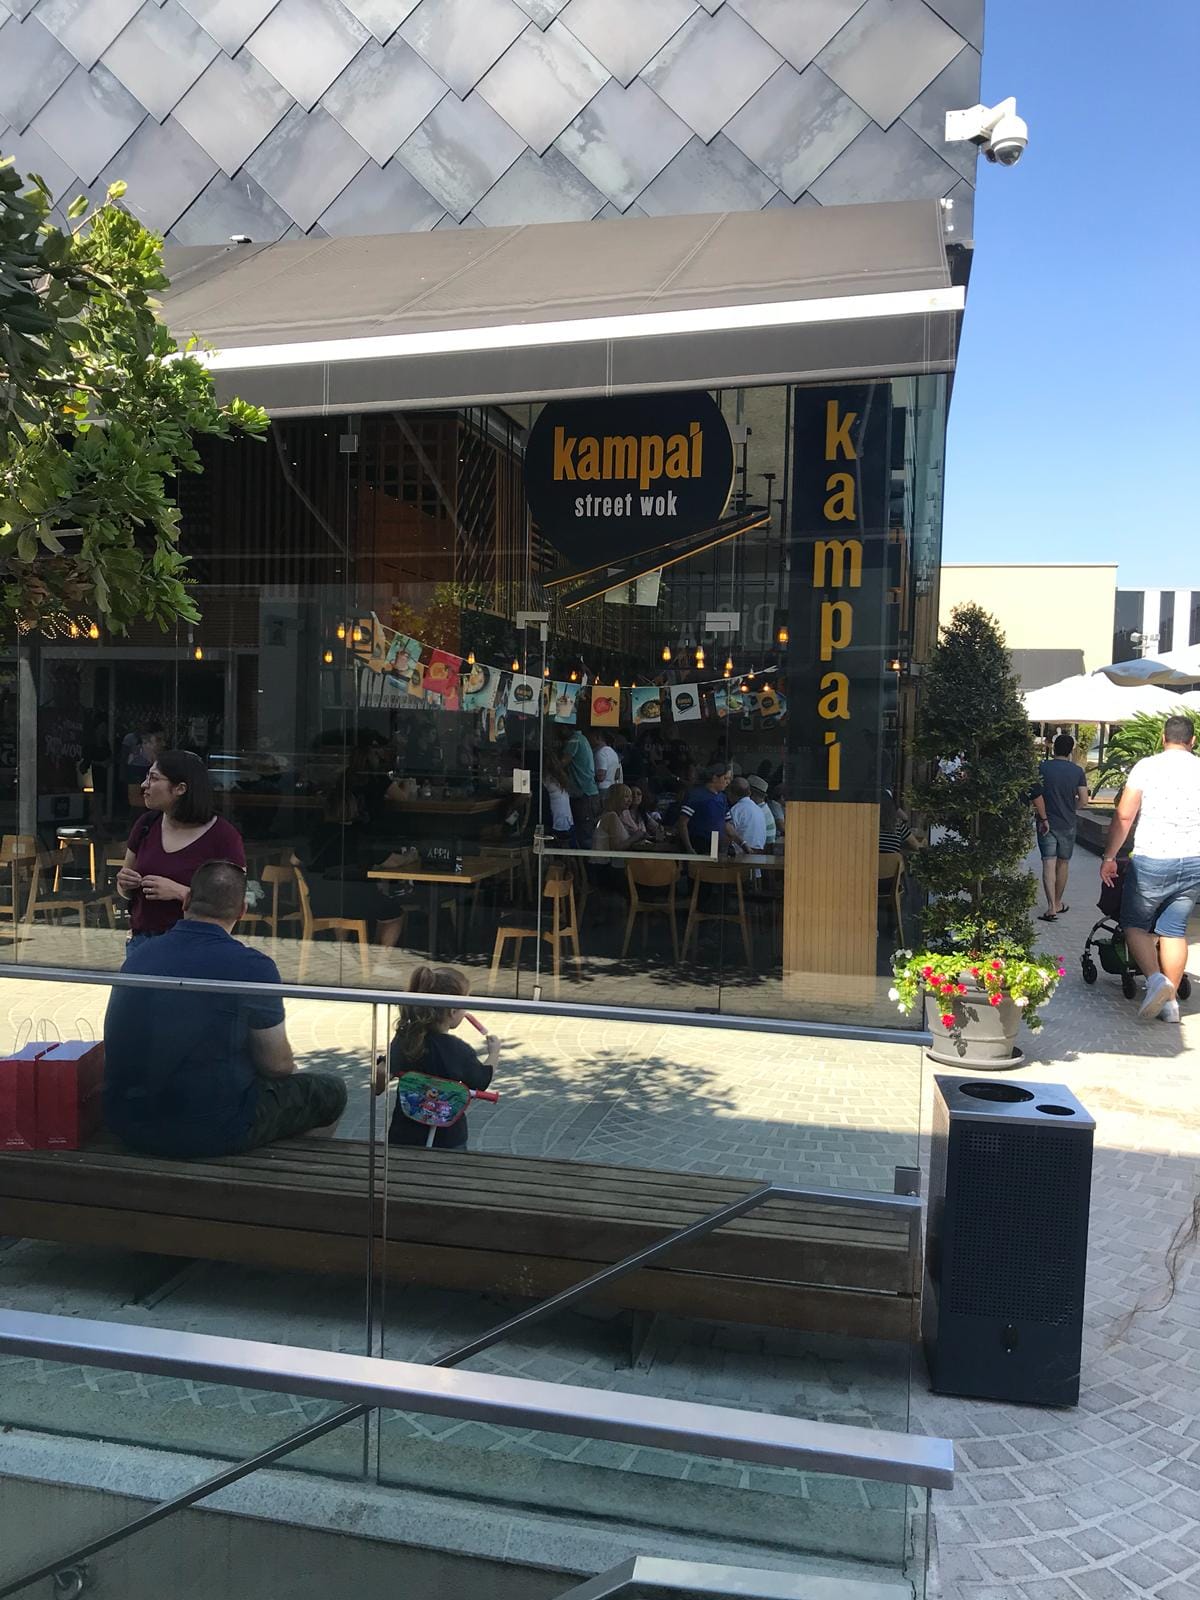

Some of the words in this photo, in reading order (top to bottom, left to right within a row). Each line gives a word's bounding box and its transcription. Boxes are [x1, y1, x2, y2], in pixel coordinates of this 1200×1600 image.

[553, 422, 703, 490] kampai
[574, 493, 633, 517] street
[639, 490, 678, 516] wok
[814, 400, 862, 790] kampai
